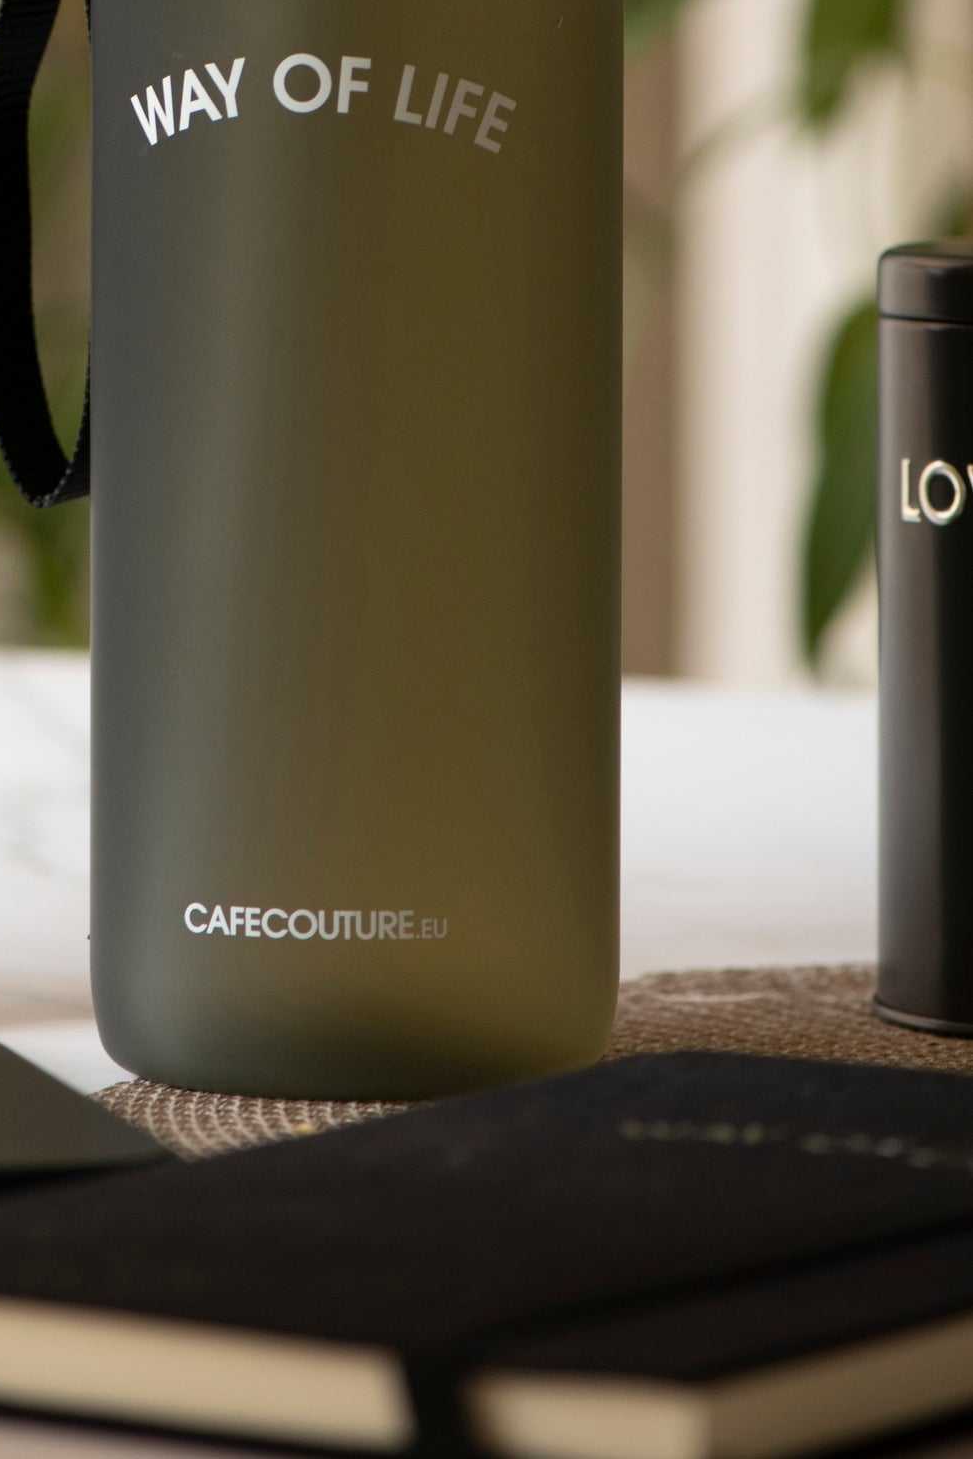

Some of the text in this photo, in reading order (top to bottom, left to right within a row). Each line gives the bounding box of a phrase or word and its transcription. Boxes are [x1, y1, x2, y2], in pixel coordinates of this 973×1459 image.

[130, 53, 517, 154] WAY OF LIFE
[184, 902, 447, 940] CAFECOUTURE.EU
